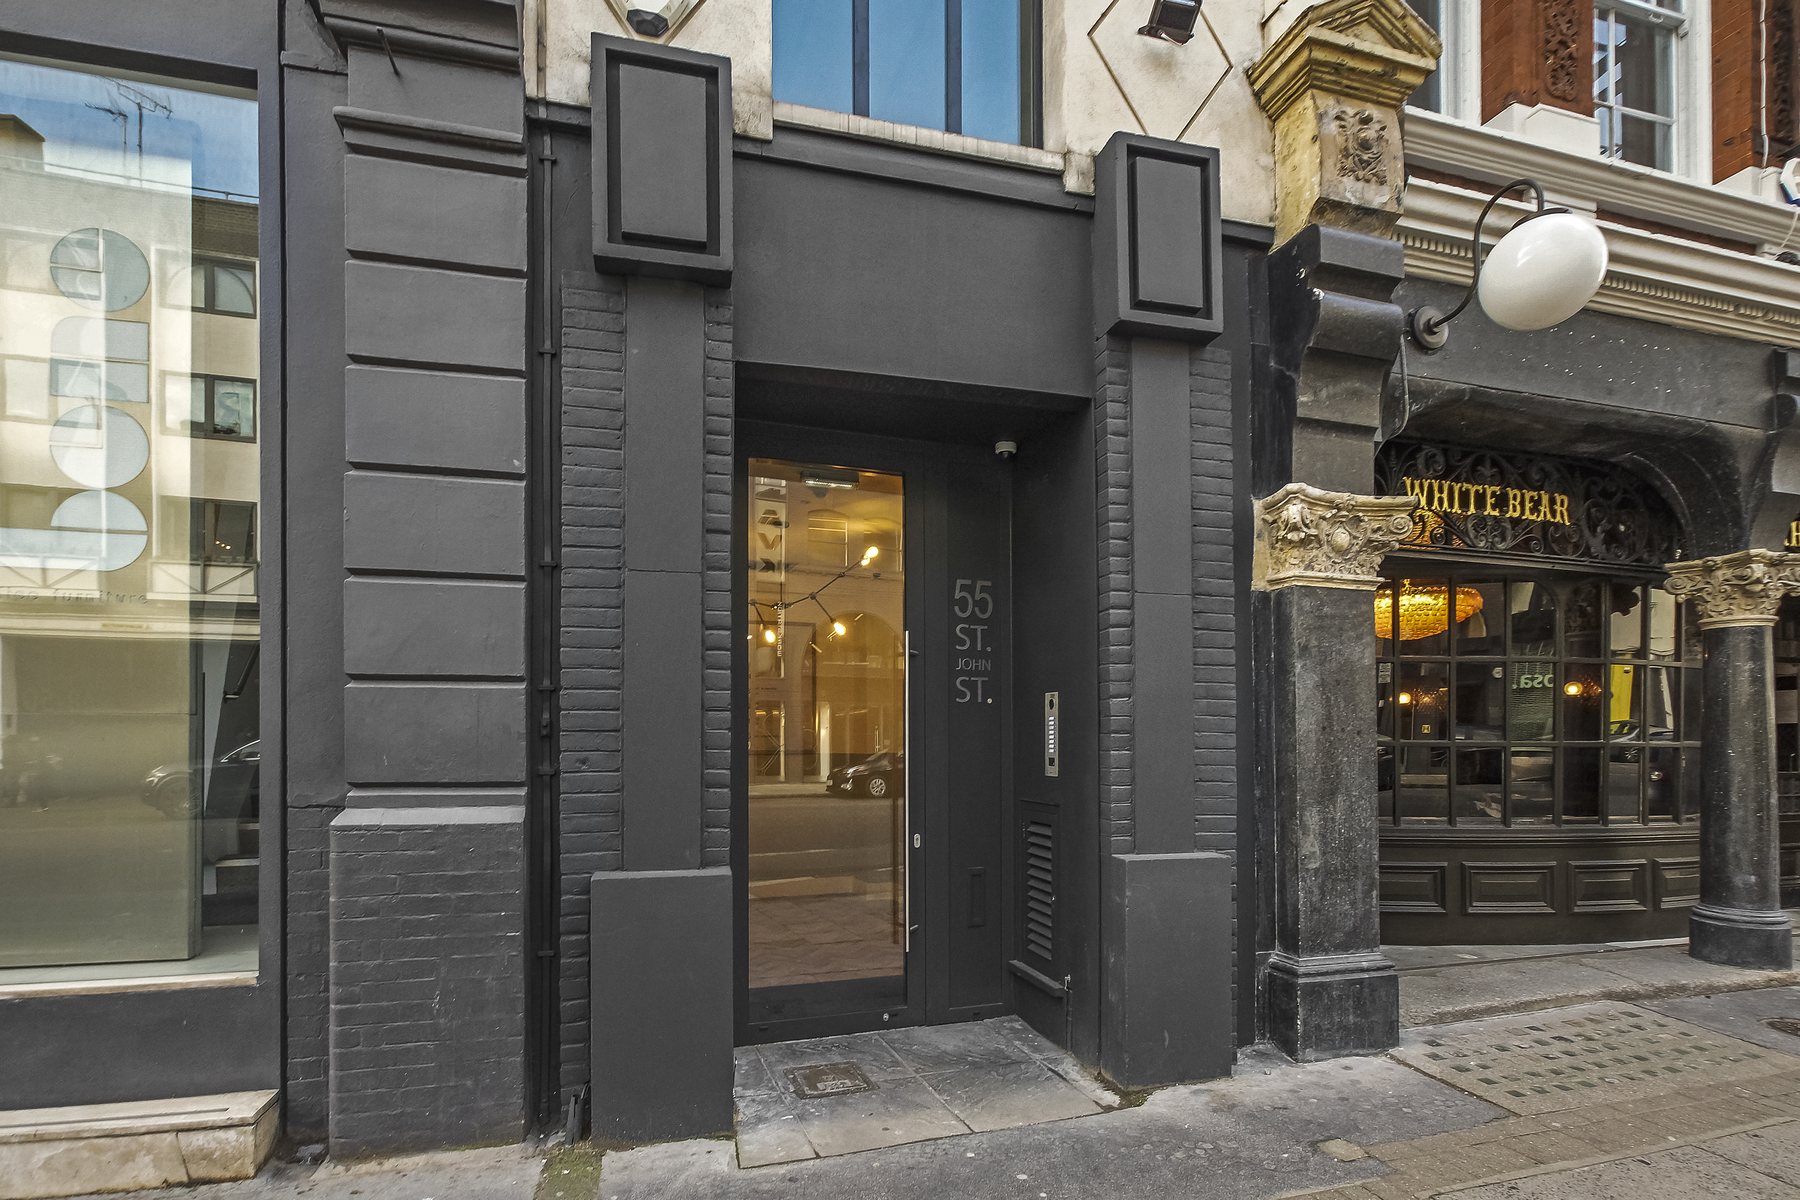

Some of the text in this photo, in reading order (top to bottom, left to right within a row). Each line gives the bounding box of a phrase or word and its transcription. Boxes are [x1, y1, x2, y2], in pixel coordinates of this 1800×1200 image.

[1402, 476, 1571, 526] WHITE BEAR
[954, 578, 994, 619] 55
[955, 623, 992, 652] ST.
[955, 657, 992, 671] JOHN
[955, 676, 993, 704] ST.
